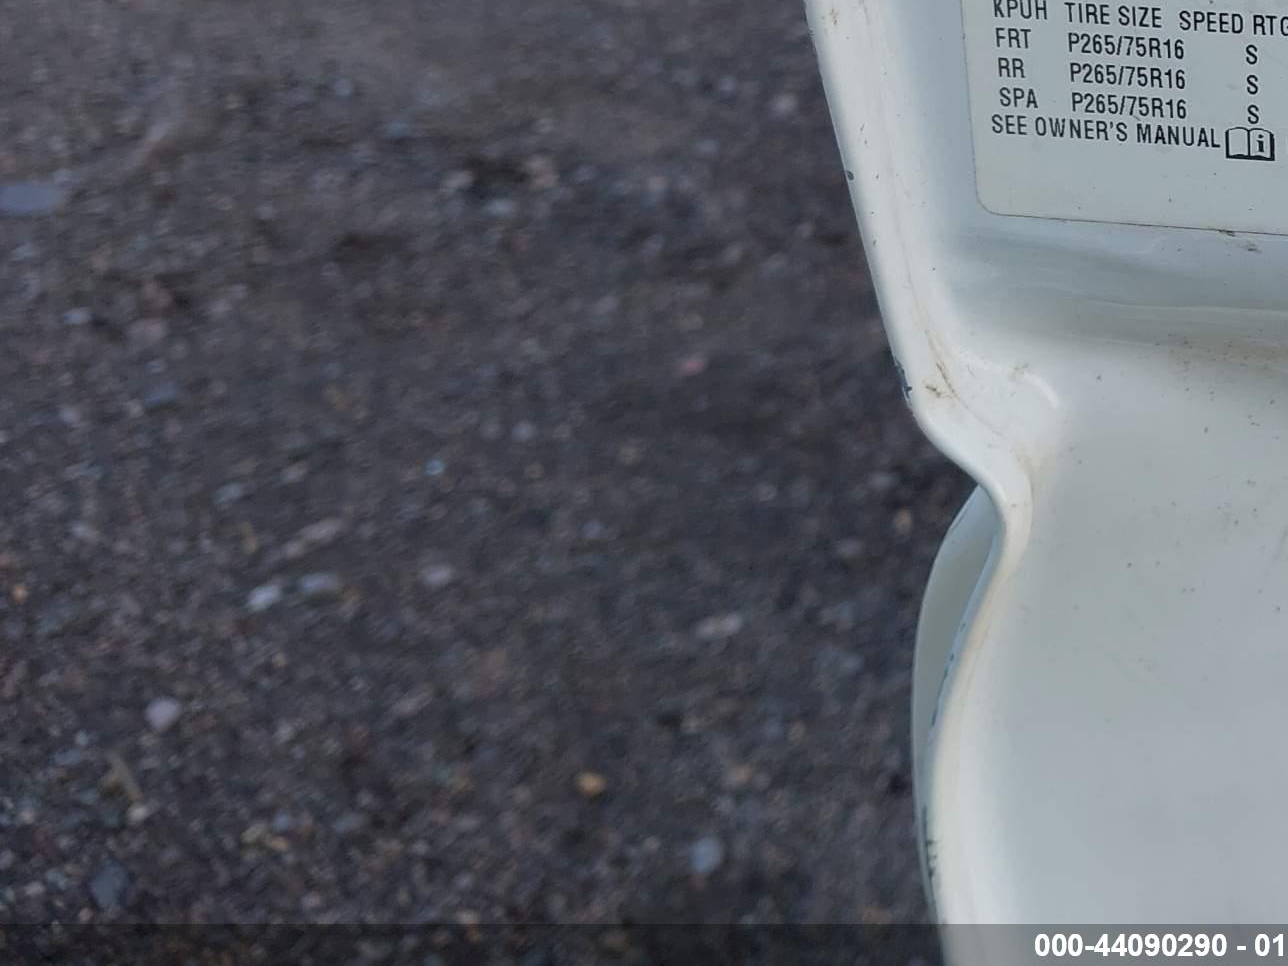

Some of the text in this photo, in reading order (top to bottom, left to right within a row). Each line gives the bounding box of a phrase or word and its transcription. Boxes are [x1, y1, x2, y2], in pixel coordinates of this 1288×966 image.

[1063, 1, 1111, 26] TIRE
[1117, 5, 1163, 29] SIZE
[1178, 10, 1244, 35] SPEED
[995, 27, 1032, 50] FRT
[1067, 31, 1185, 60] P265/75R16
[1245, 43, 1258, 66] S
[997, 56, 1026, 79] RR
[1069, 61, 1186, 90] P265/75R16
[1246, 74, 1259, 96] S
[998, 86, 1039, 109] SPA
[1071, 91, 1187, 121] P265/75R16
[1246, 104, 1260, 125] S
[991, 113, 1028, 136] SEE
[1034, 116, 1128, 142] OWNER'S
[1136, 122, 1222, 149] MANUAL
